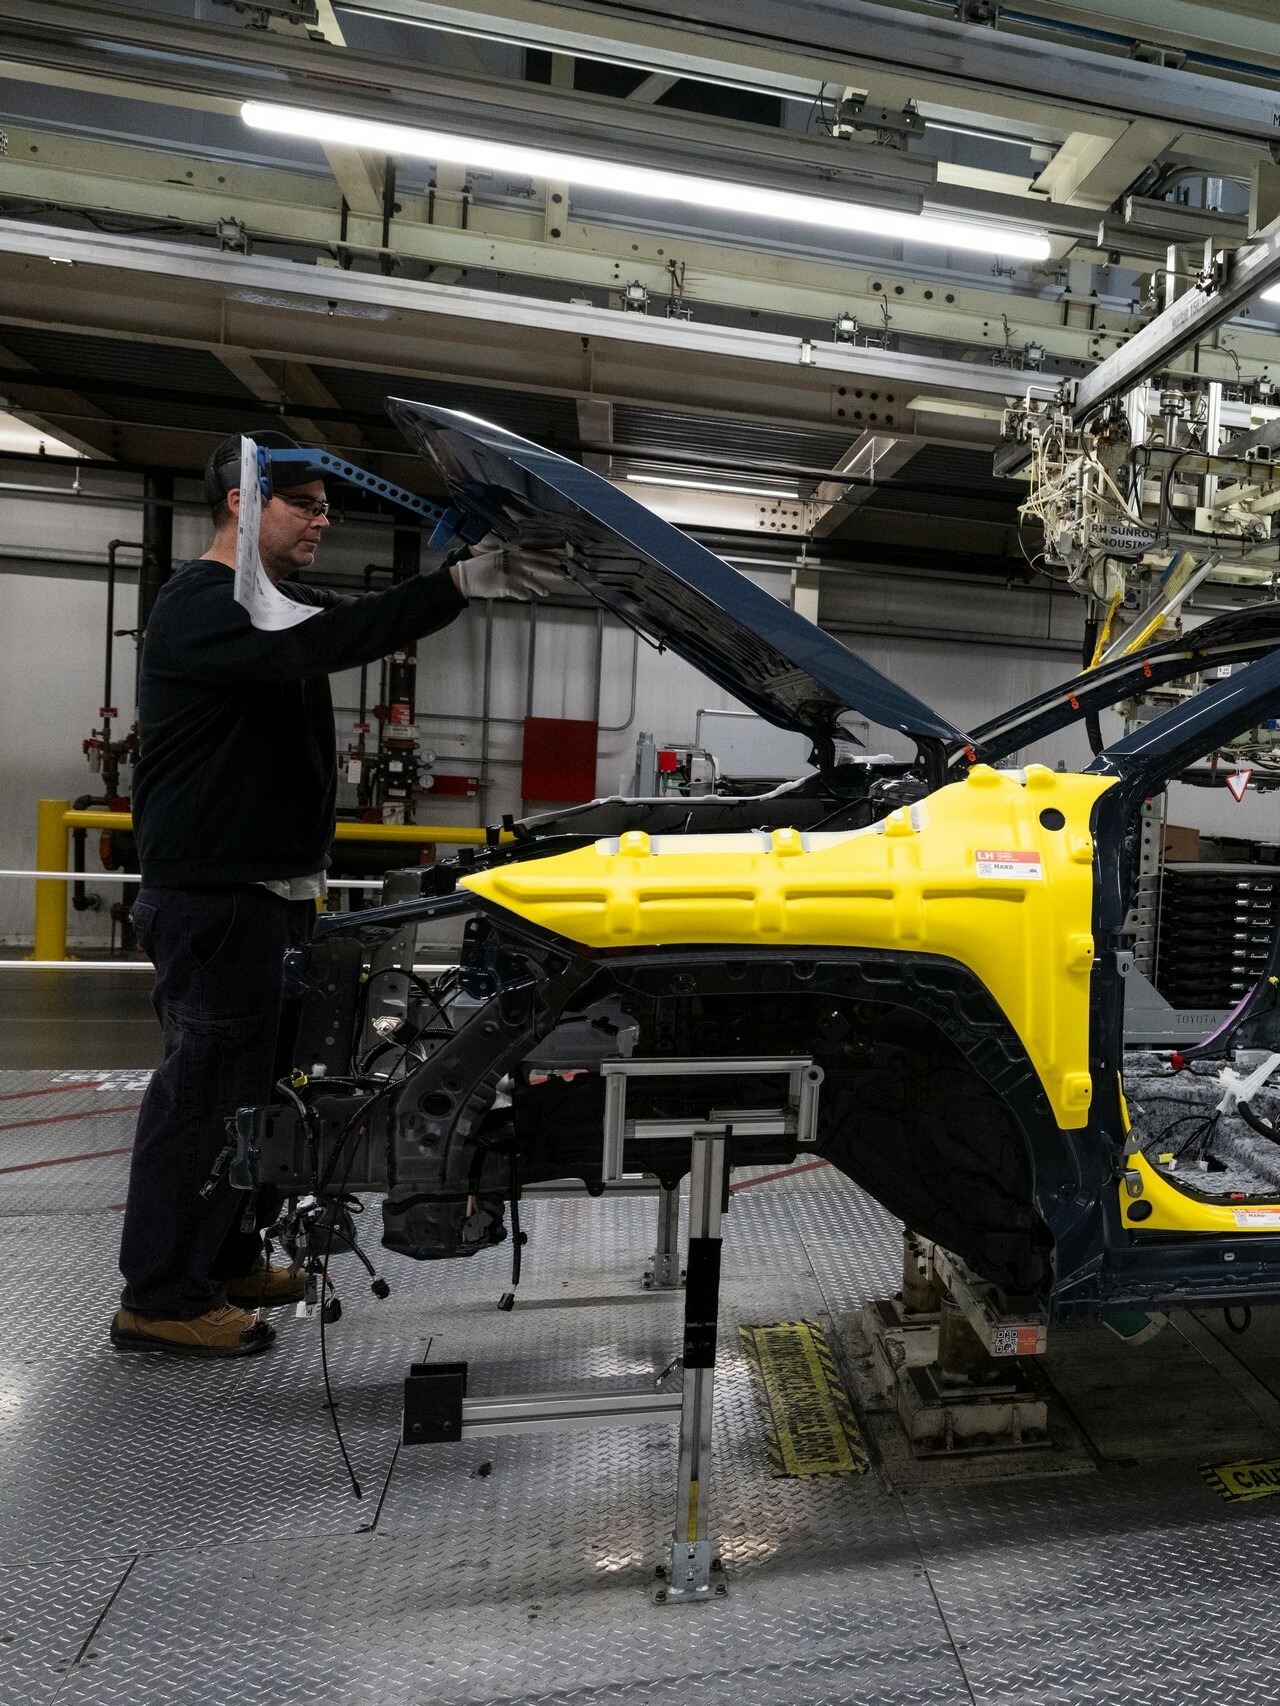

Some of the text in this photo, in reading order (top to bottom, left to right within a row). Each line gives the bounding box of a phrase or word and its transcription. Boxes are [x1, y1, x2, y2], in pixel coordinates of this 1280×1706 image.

[1092, 524, 1107, 534] RH
[1101, 537, 1152, 549] HOUSIN
[977, 852, 994, 860] LH
[1176, 1015, 1216, 1024] TOYOTA
